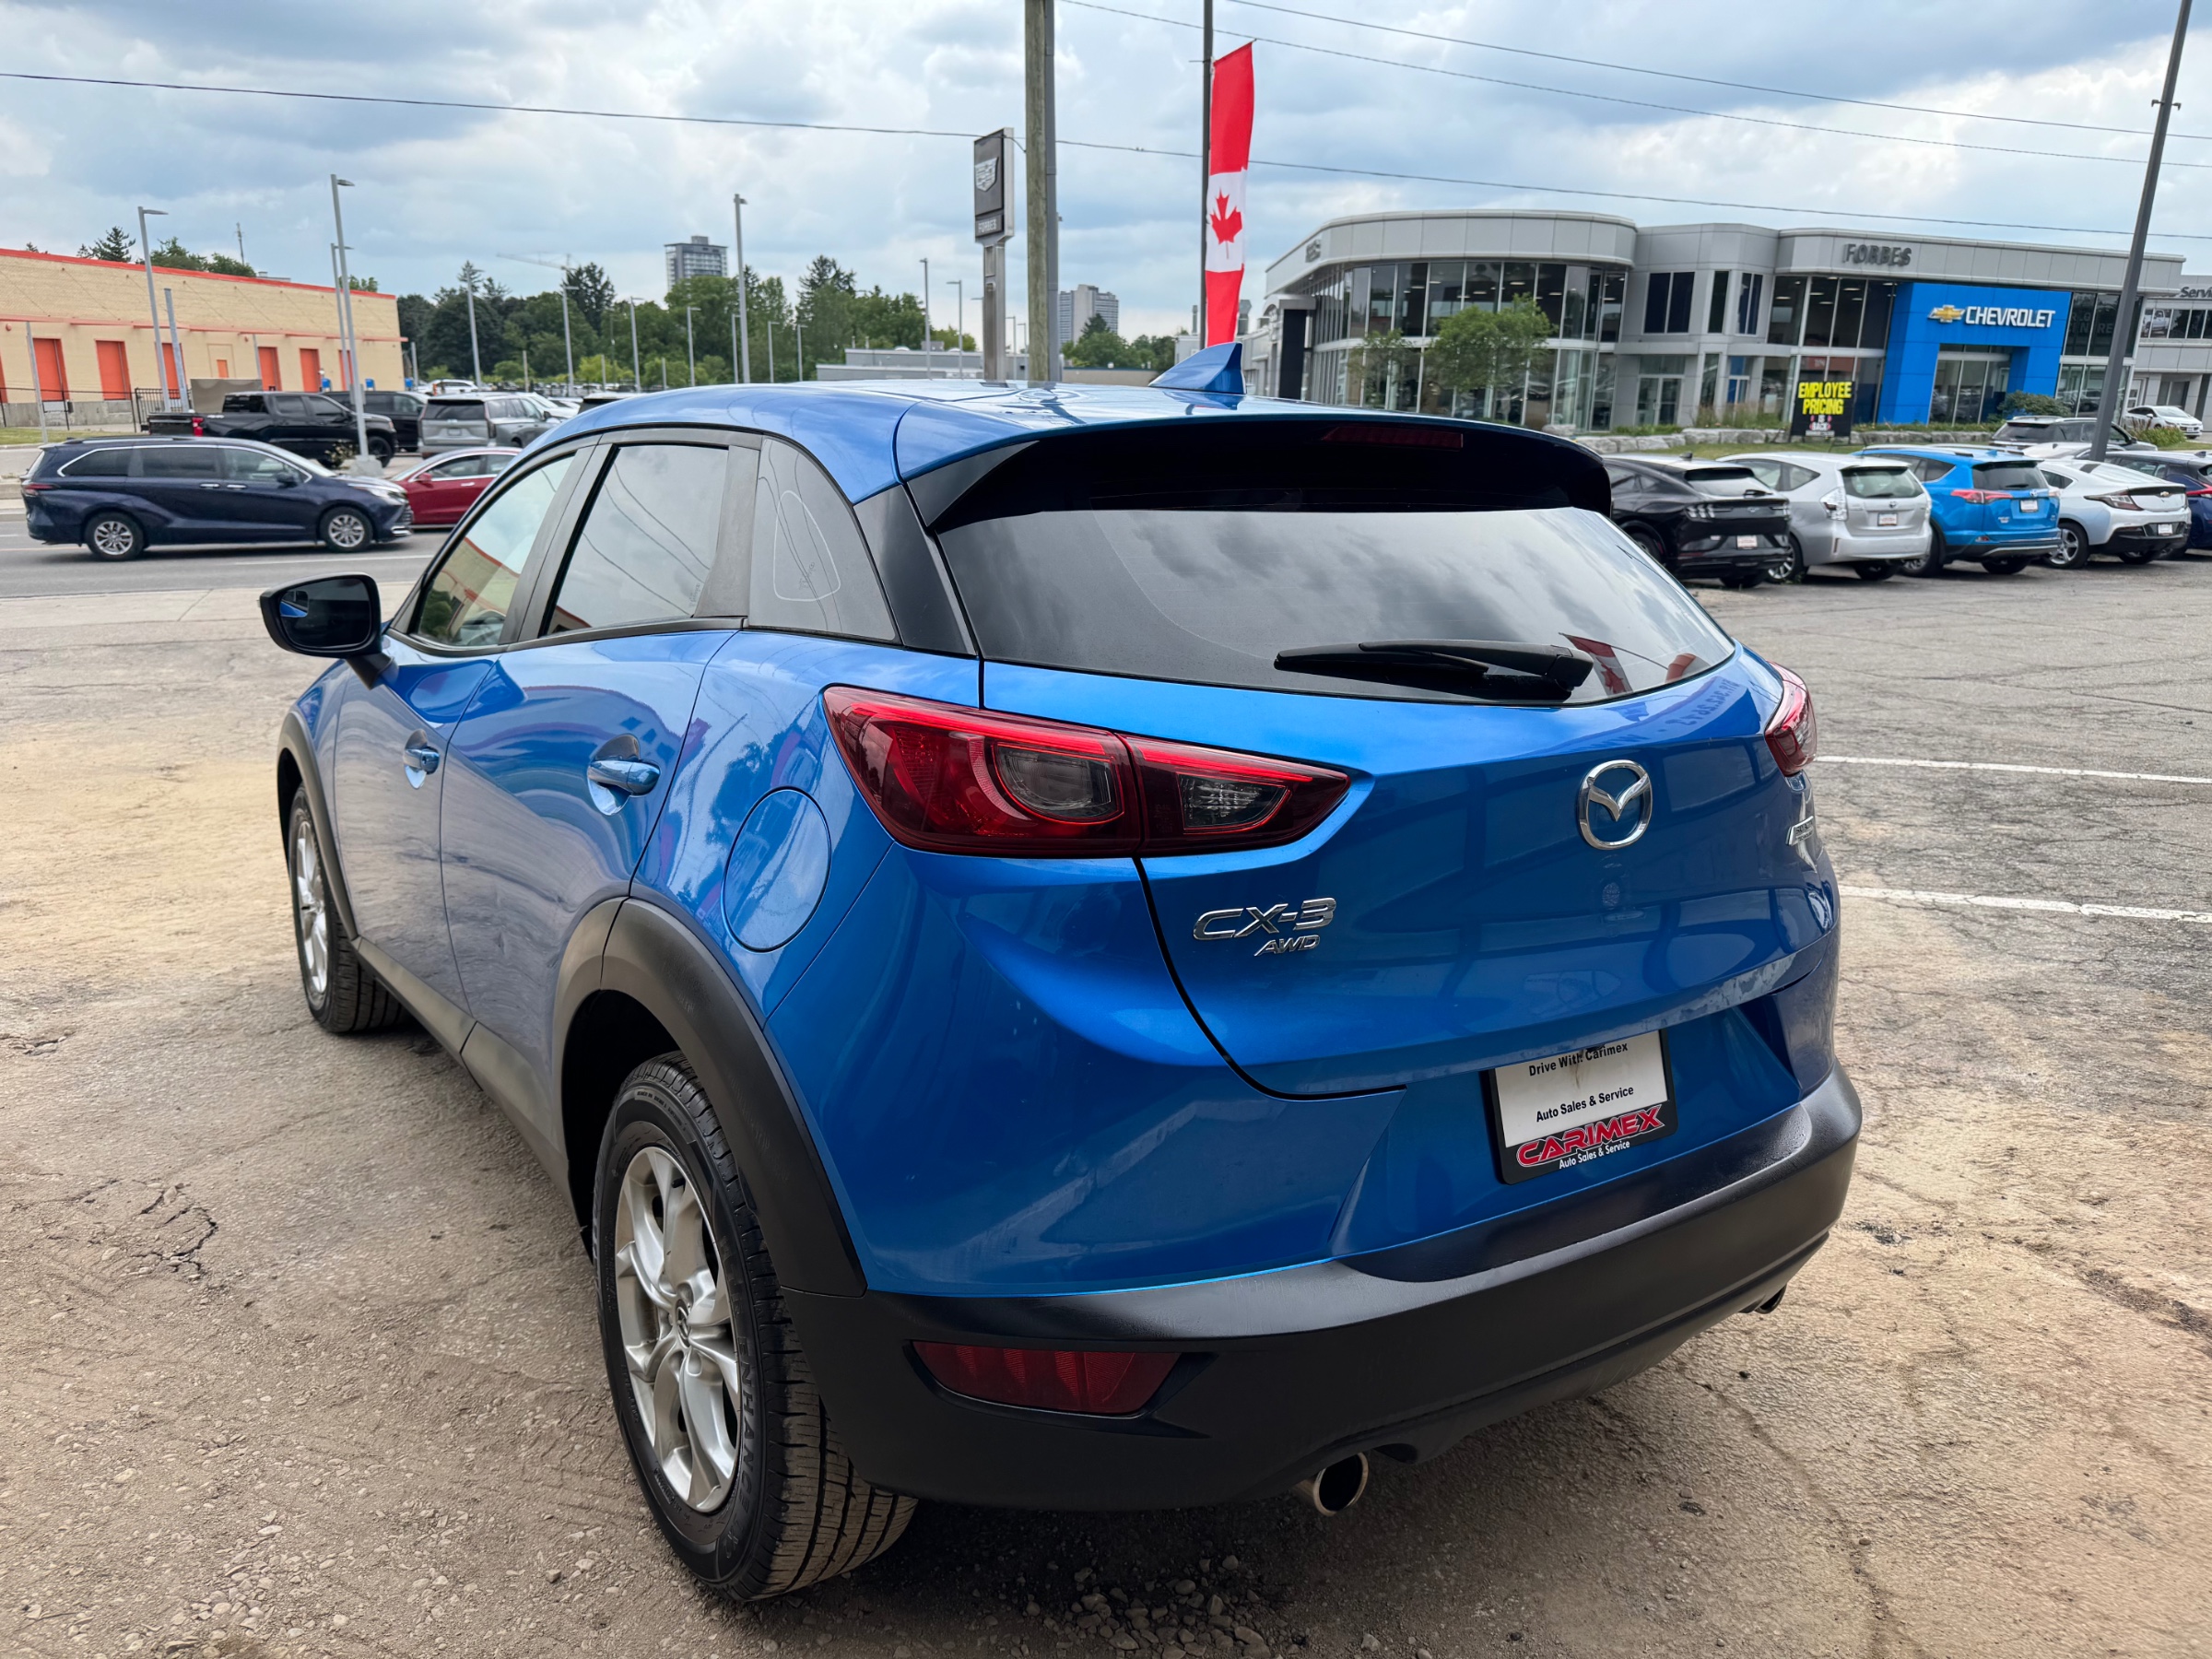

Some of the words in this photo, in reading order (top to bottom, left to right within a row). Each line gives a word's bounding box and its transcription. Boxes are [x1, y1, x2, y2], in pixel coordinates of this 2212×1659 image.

[1843, 243, 1912, 266] FORBES
[1965, 305, 2056, 328] CHEVROLET
[1798, 382, 1853, 399] EMPLOYEE
[1802, 398, 1844, 415] PRICING
[1193, 897, 1337, 941] CX-3
[1253, 934, 1321, 957] AWD
[1528, 1061, 1557, 1077] Drive
[1558, 1052, 1583, 1068] With
[1585, 1041, 1629, 1061] Carimex
[1535, 1108, 1559, 1123] Auto
[1560, 1100, 1587, 1115] Sales
[1589, 1095, 1597, 1107] &
[1598, 1086, 1634, 1104] Service
[1517, 1105, 1664, 1167] CARIMEX
[1559, 1158, 1577, 1170] Auto
[1577, 1149, 1597, 1165] Sales
[1598, 1147, 1605, 1157] &
[1605, 1140, 1630, 1155] Service
[738, 1336, 755, 1514] ENHANCE
